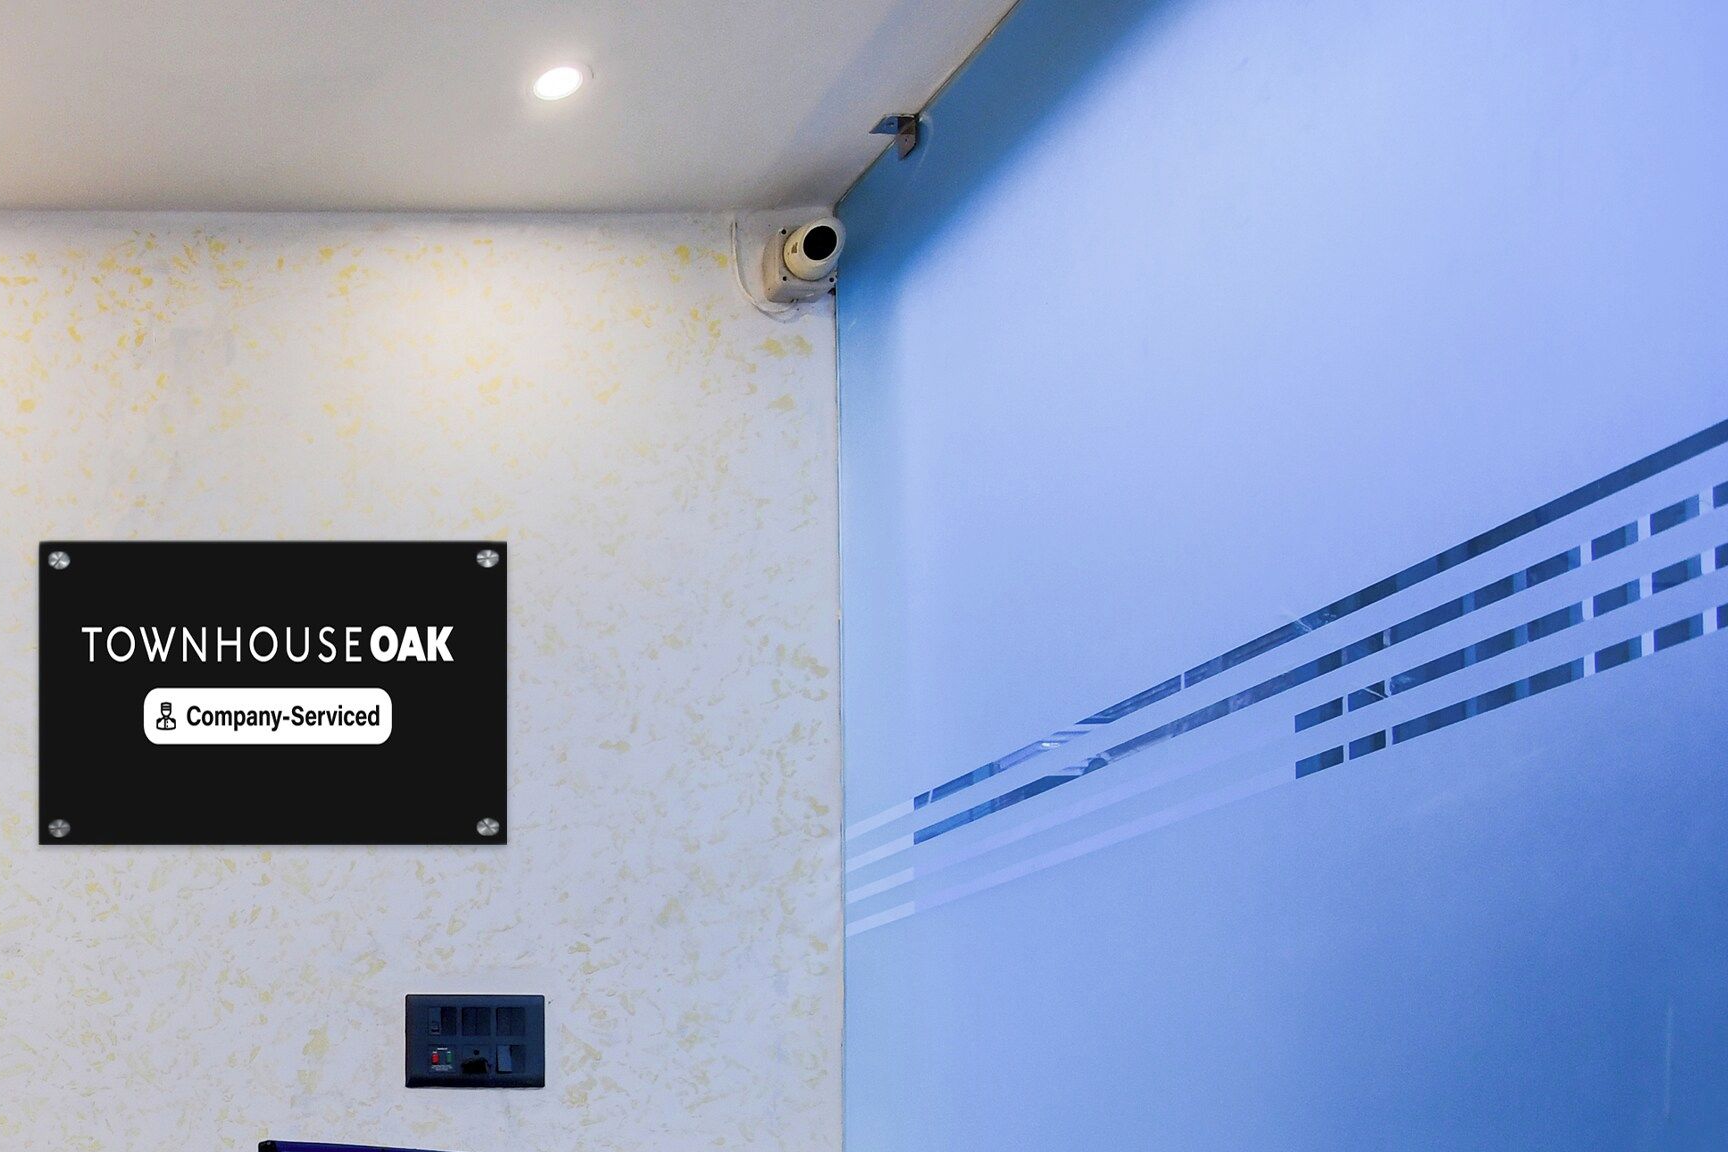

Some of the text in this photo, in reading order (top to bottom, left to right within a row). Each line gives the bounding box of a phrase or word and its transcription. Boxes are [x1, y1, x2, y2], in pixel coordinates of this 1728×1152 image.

[82, 625, 454, 663] TOWNHOUSE OAK
[186, 704, 380, 732] Company-Serviced
